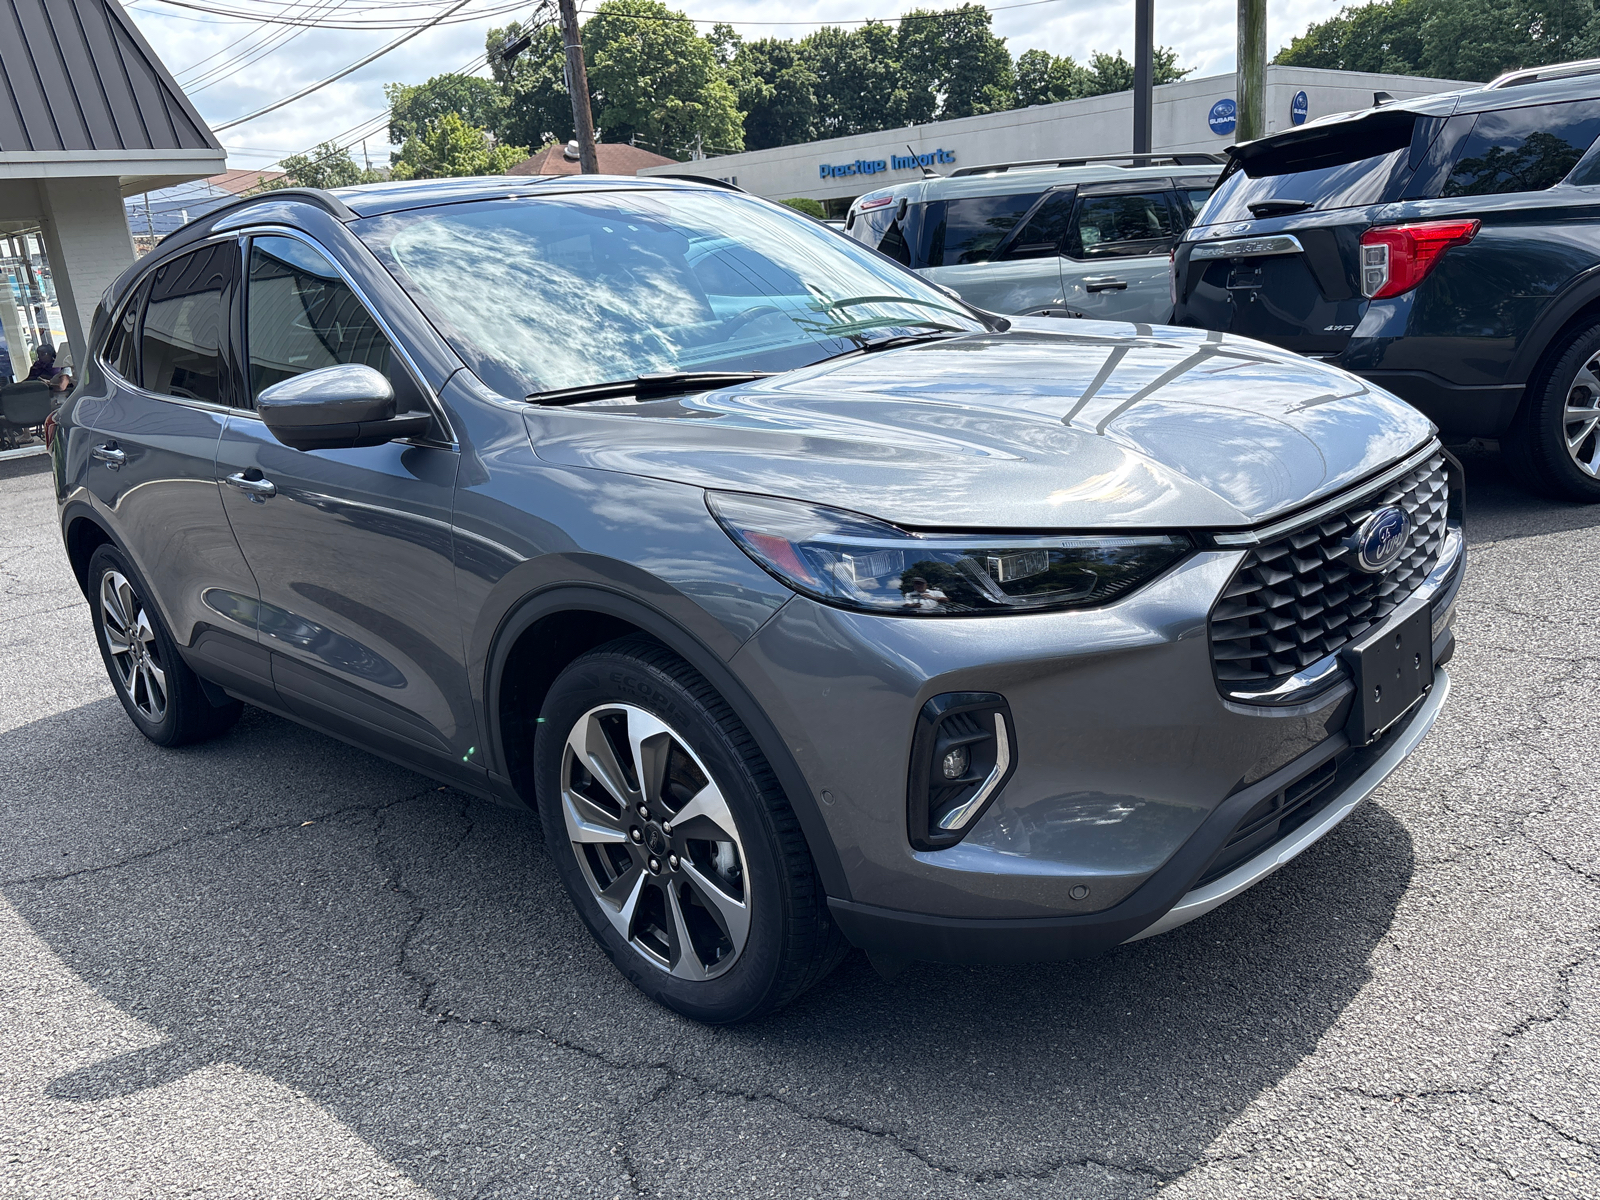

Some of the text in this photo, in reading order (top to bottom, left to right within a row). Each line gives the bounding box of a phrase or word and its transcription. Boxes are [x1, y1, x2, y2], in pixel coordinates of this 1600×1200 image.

[819, 148, 956, 179] Prestige Imports
[1201, 242, 1274, 256] EXPLORER
[1376, 521, 1403, 559] Ford
